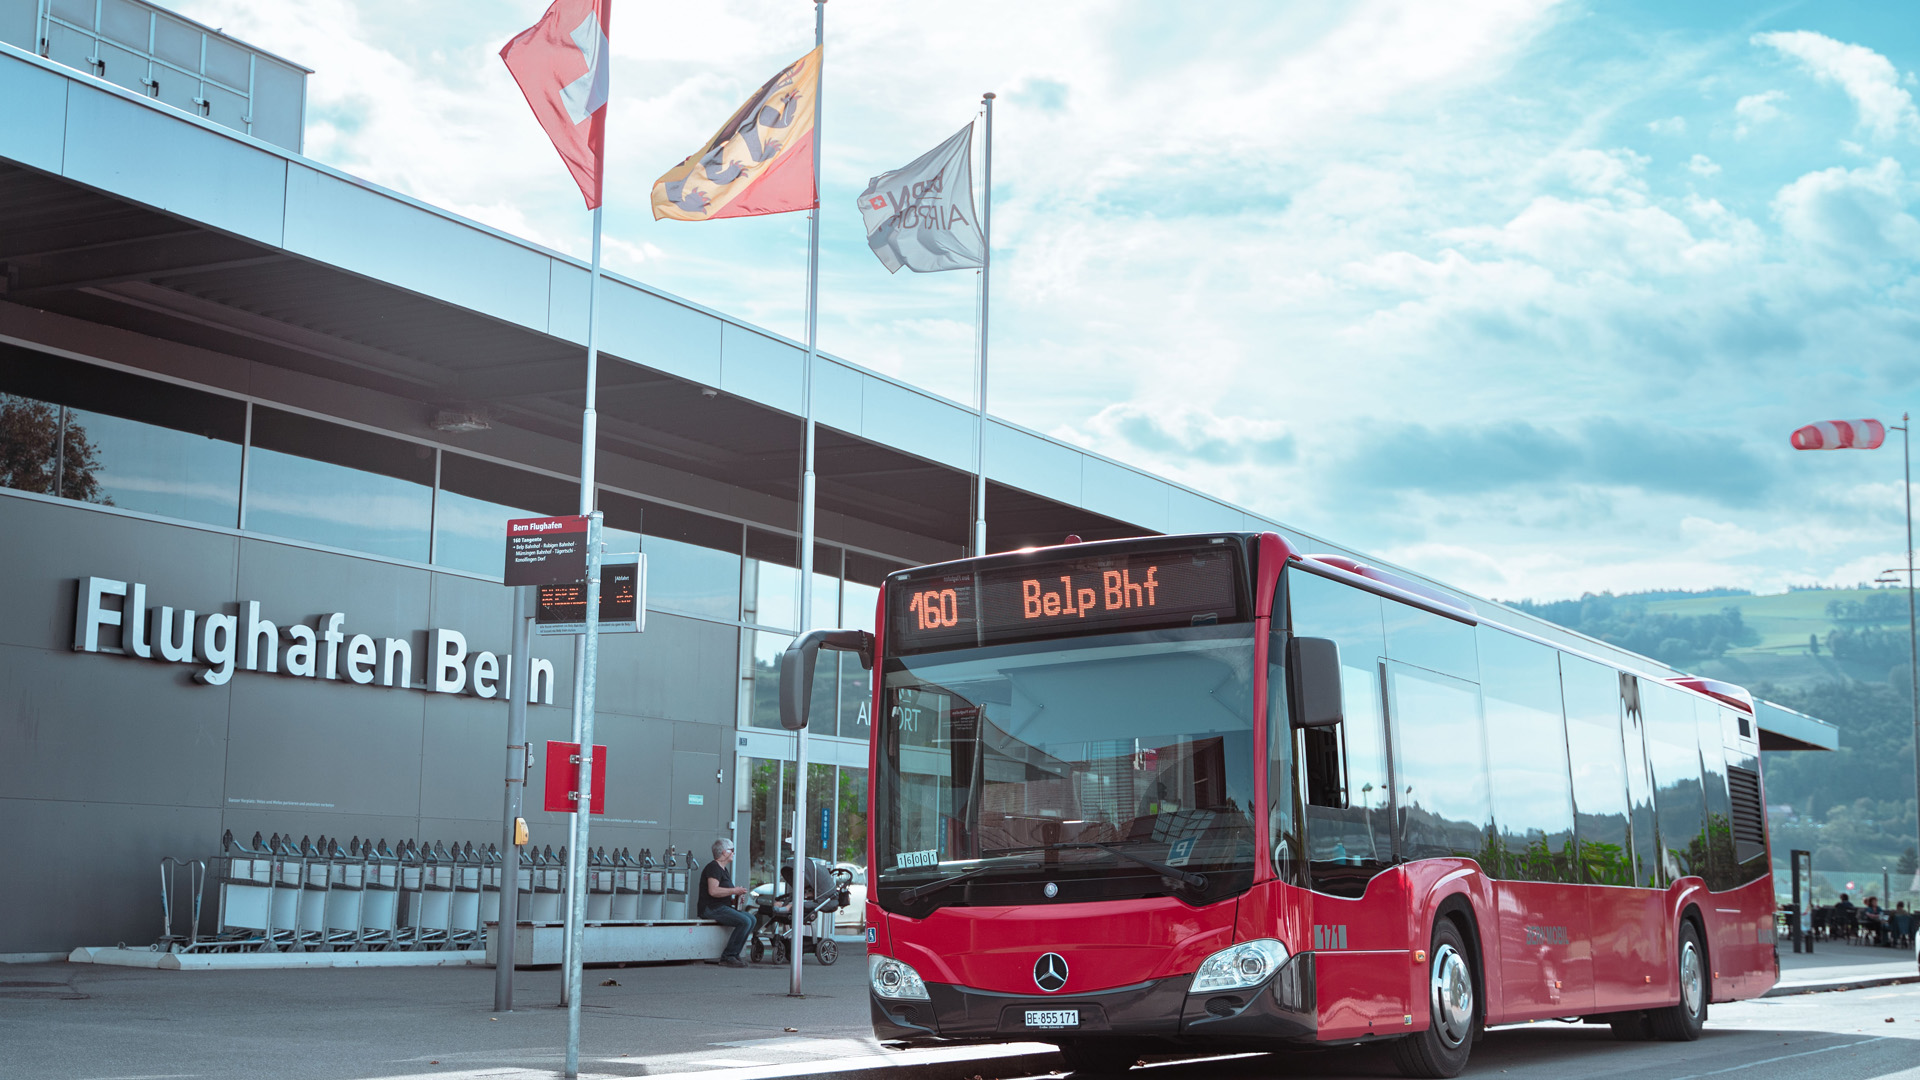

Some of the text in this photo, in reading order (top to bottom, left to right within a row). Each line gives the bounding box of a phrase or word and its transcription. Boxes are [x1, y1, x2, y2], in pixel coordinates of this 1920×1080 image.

[513, 521, 563, 532] Bern Flughafen
[909, 565, 1159, 630] 160 Belp Bhf
[76, 576, 412, 688] Flughafen
[899, 854, 936, 866] 16001
